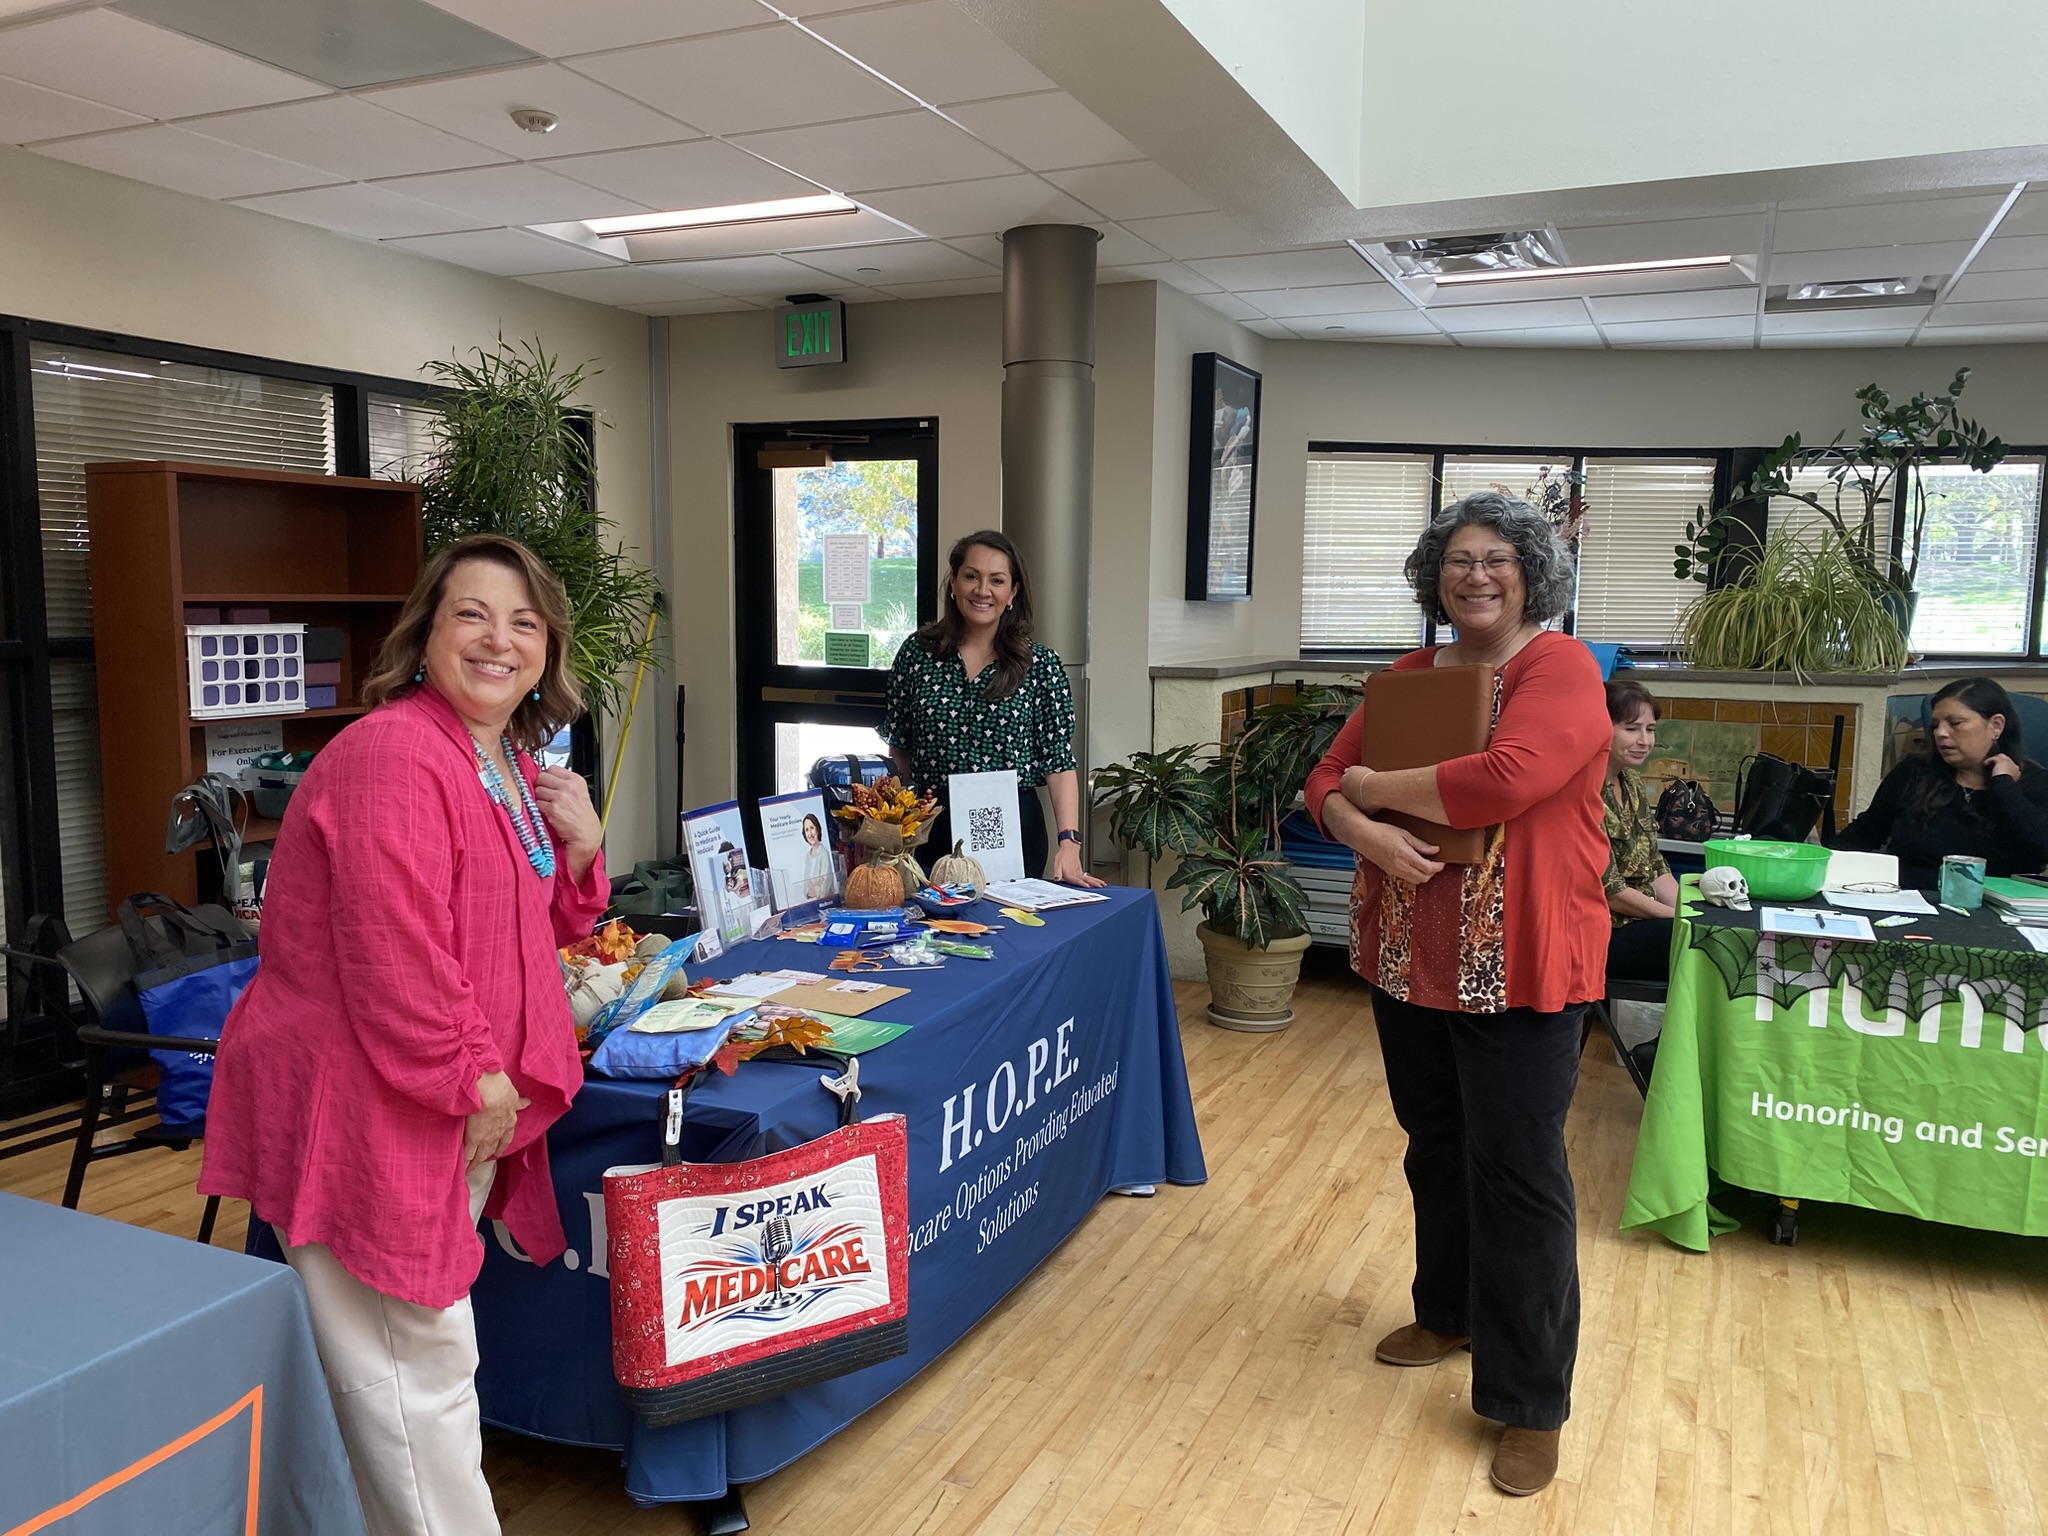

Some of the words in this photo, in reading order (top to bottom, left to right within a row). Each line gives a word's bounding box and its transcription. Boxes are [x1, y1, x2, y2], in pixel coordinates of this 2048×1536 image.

[786, 311, 832, 356] EXIT
[211, 749, 227, 757] For
[228, 745, 263, 756] Exercise
[264, 743, 279, 751] Use
[236, 756, 255, 766] Only
[697, 829, 709, 838] Quick
[709, 826, 721, 834] Guide
[700, 836, 718, 846] Medicare
[1755, 931, 2048, 1054] Hum
[939, 1016, 1079, 1174] H.O.P.E.
[1751, 1091, 1905, 1144] Honoring
[1914, 1121, 1984, 1149] and
[955, 1154, 1011, 1221] Options
[1013, 1107, 1069, 1173] Providing
[1069, 1061, 1119, 1124] Educated
[709, 1206, 730, 1238] I
[733, 1183, 832, 1230] SPEAK
[976, 1181, 1040, 1255] Solutions
[677, 1236, 872, 1329] MEDICARE
